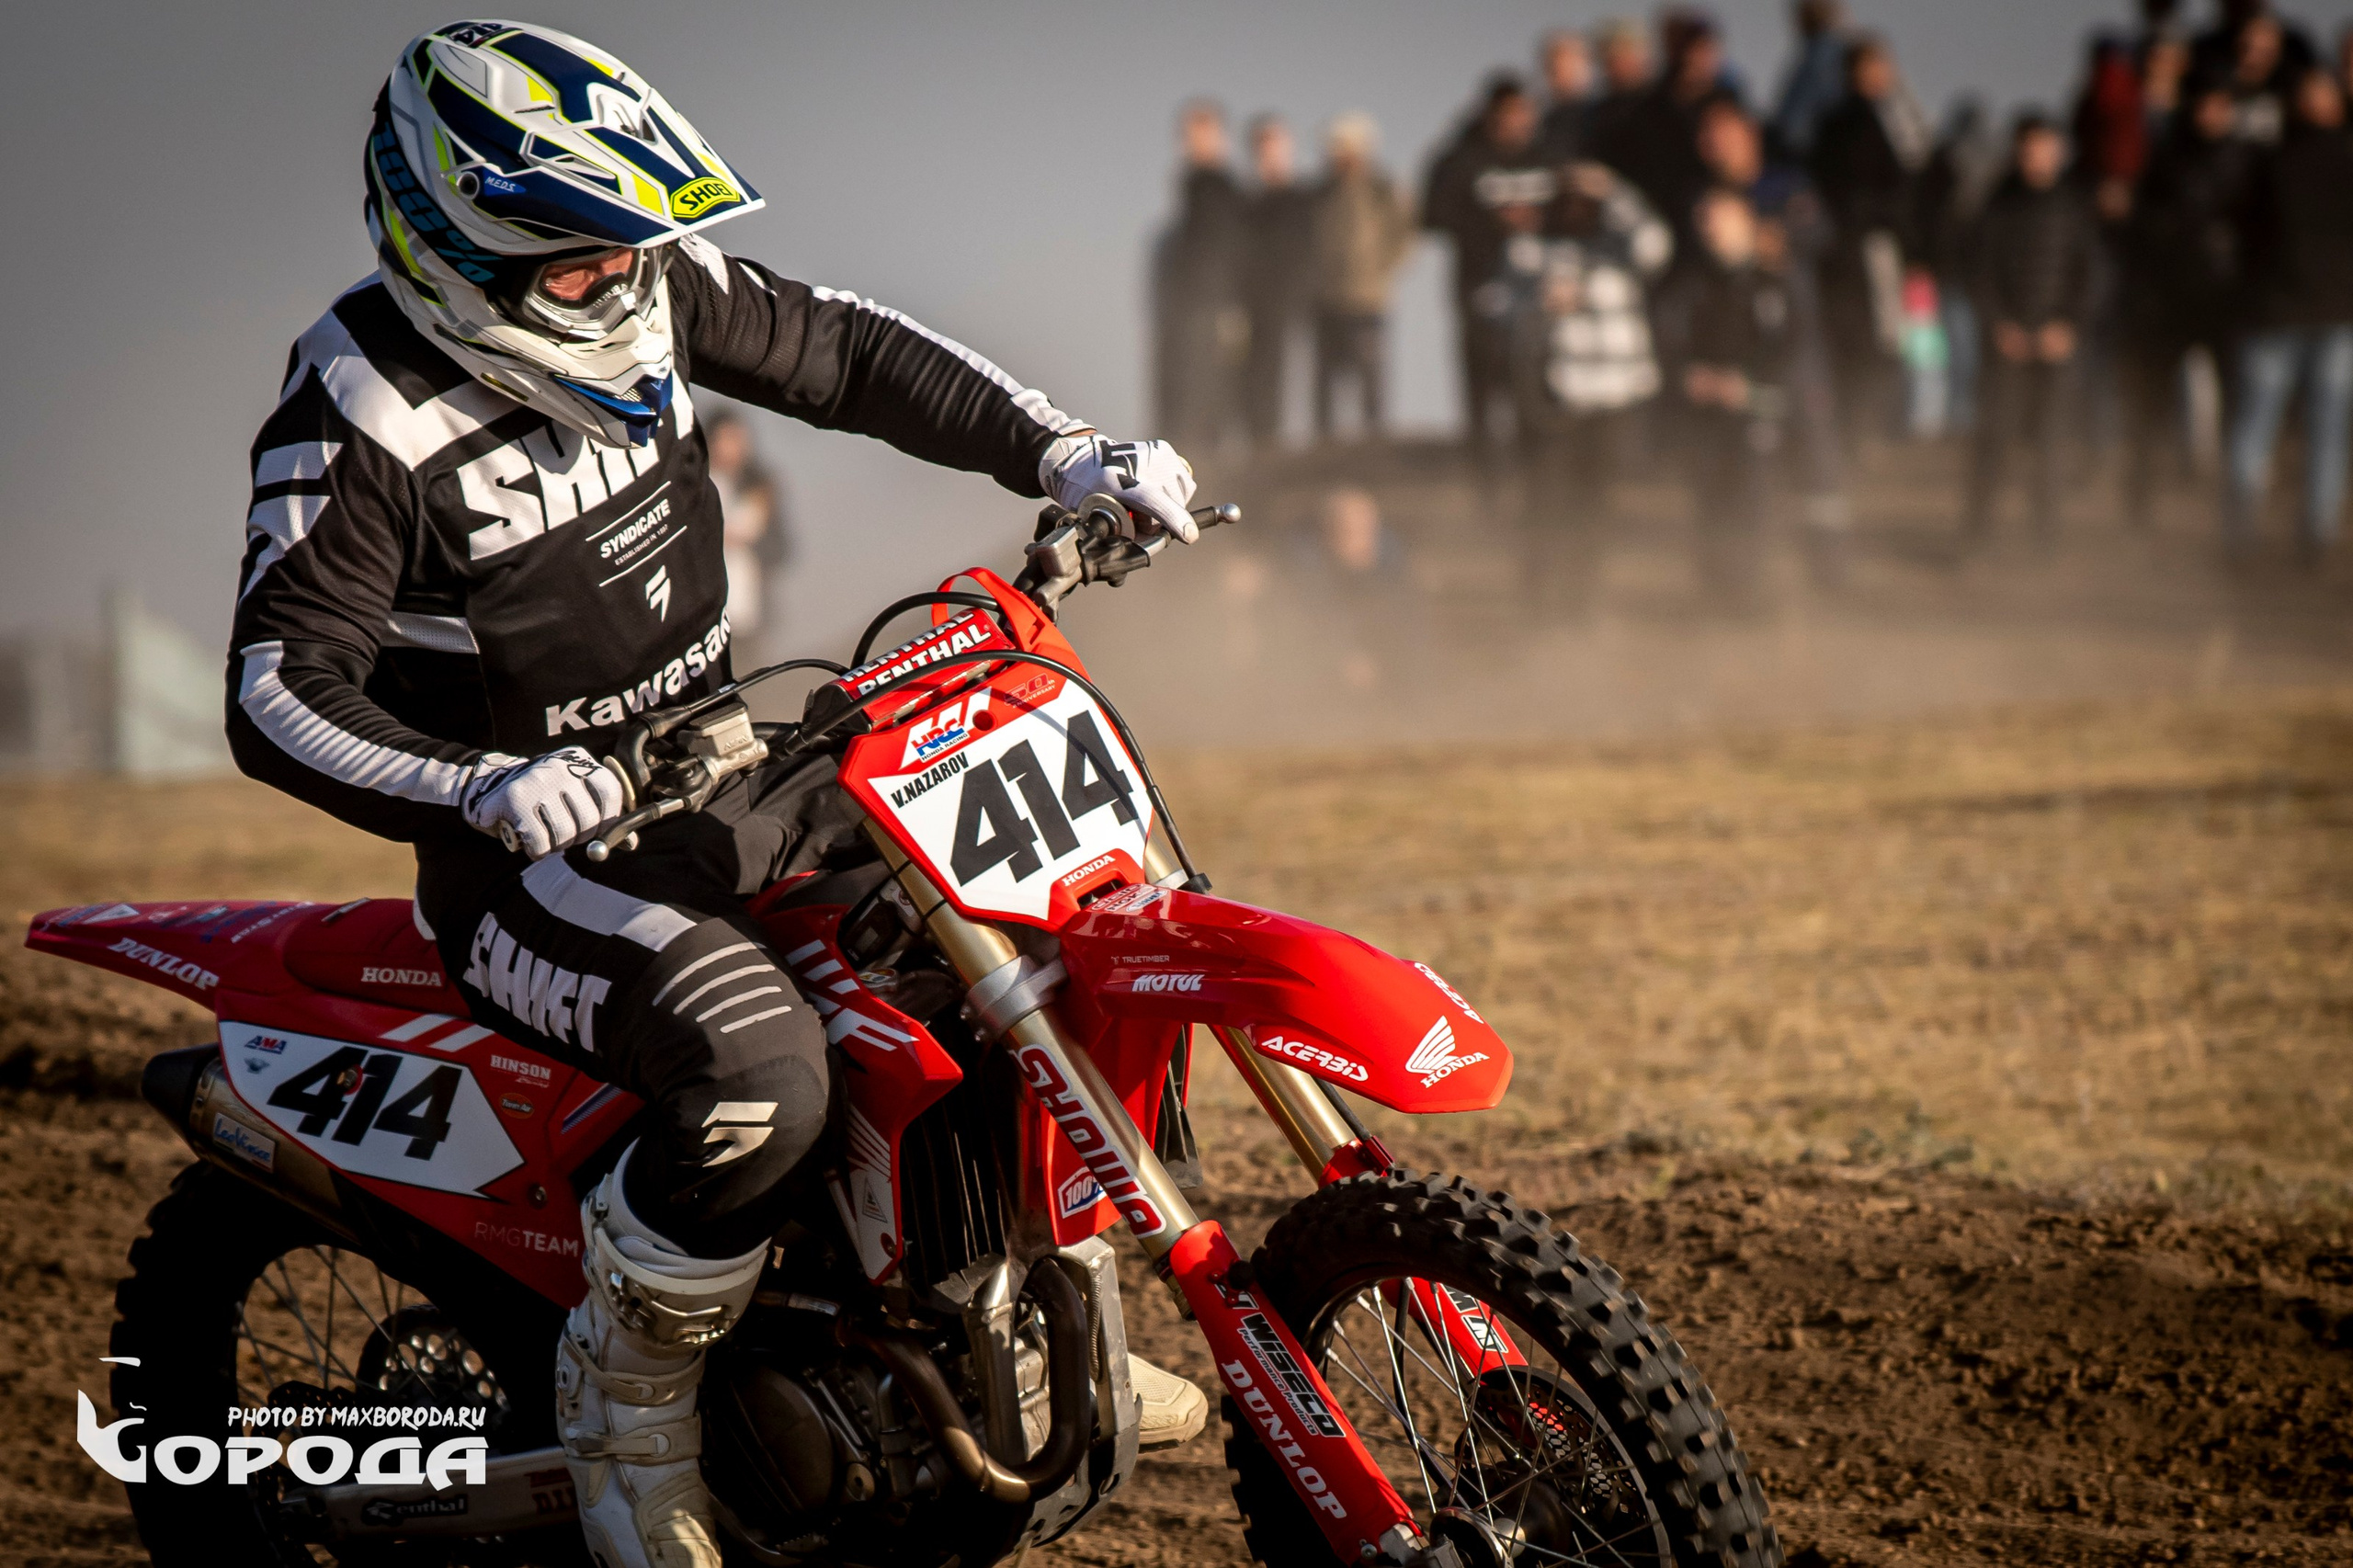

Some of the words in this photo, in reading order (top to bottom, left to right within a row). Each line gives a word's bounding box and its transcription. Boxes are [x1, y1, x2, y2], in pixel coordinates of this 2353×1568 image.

[679, 183, 733, 211] SHOEI
[600, 498, 671, 559] SYNDICATE
[614, 538, 652, 566] ESTABLISHED
[649, 533, 657, 542] IN
[911, 717, 965, 756] HRC
[921, 747, 944, 762] HONDA
[944, 733, 969, 747] RACING
[891, 751, 970, 809] V.NAZAROV
[950, 710, 1140, 888] 414
[1062, 856, 1116, 887] HONDA
[107, 937, 221, 991] DUNLOP
[360, 966, 443, 987] HONDA
[1121, 954, 1170, 964] TRUETIMBER
[461, 911, 613, 1052] SHIFT
[1131, 973, 1205, 993] MOTUL
[245, 1035, 287, 1051] AMA
[1261, 1036, 1370, 1081] ACERBIS
[490, 1054, 551, 1080] HINSON
[1420, 1051, 1490, 1088] HONDA
[266, 1046, 462, 1161] 414
[1009, 1044, 1166, 1238] SHOWA
[1238, 1329, 1285, 1389] Performance
[1283, 1392, 1317, 1435] Products
[1222, 1359, 1347, 1518] DUNLOP
